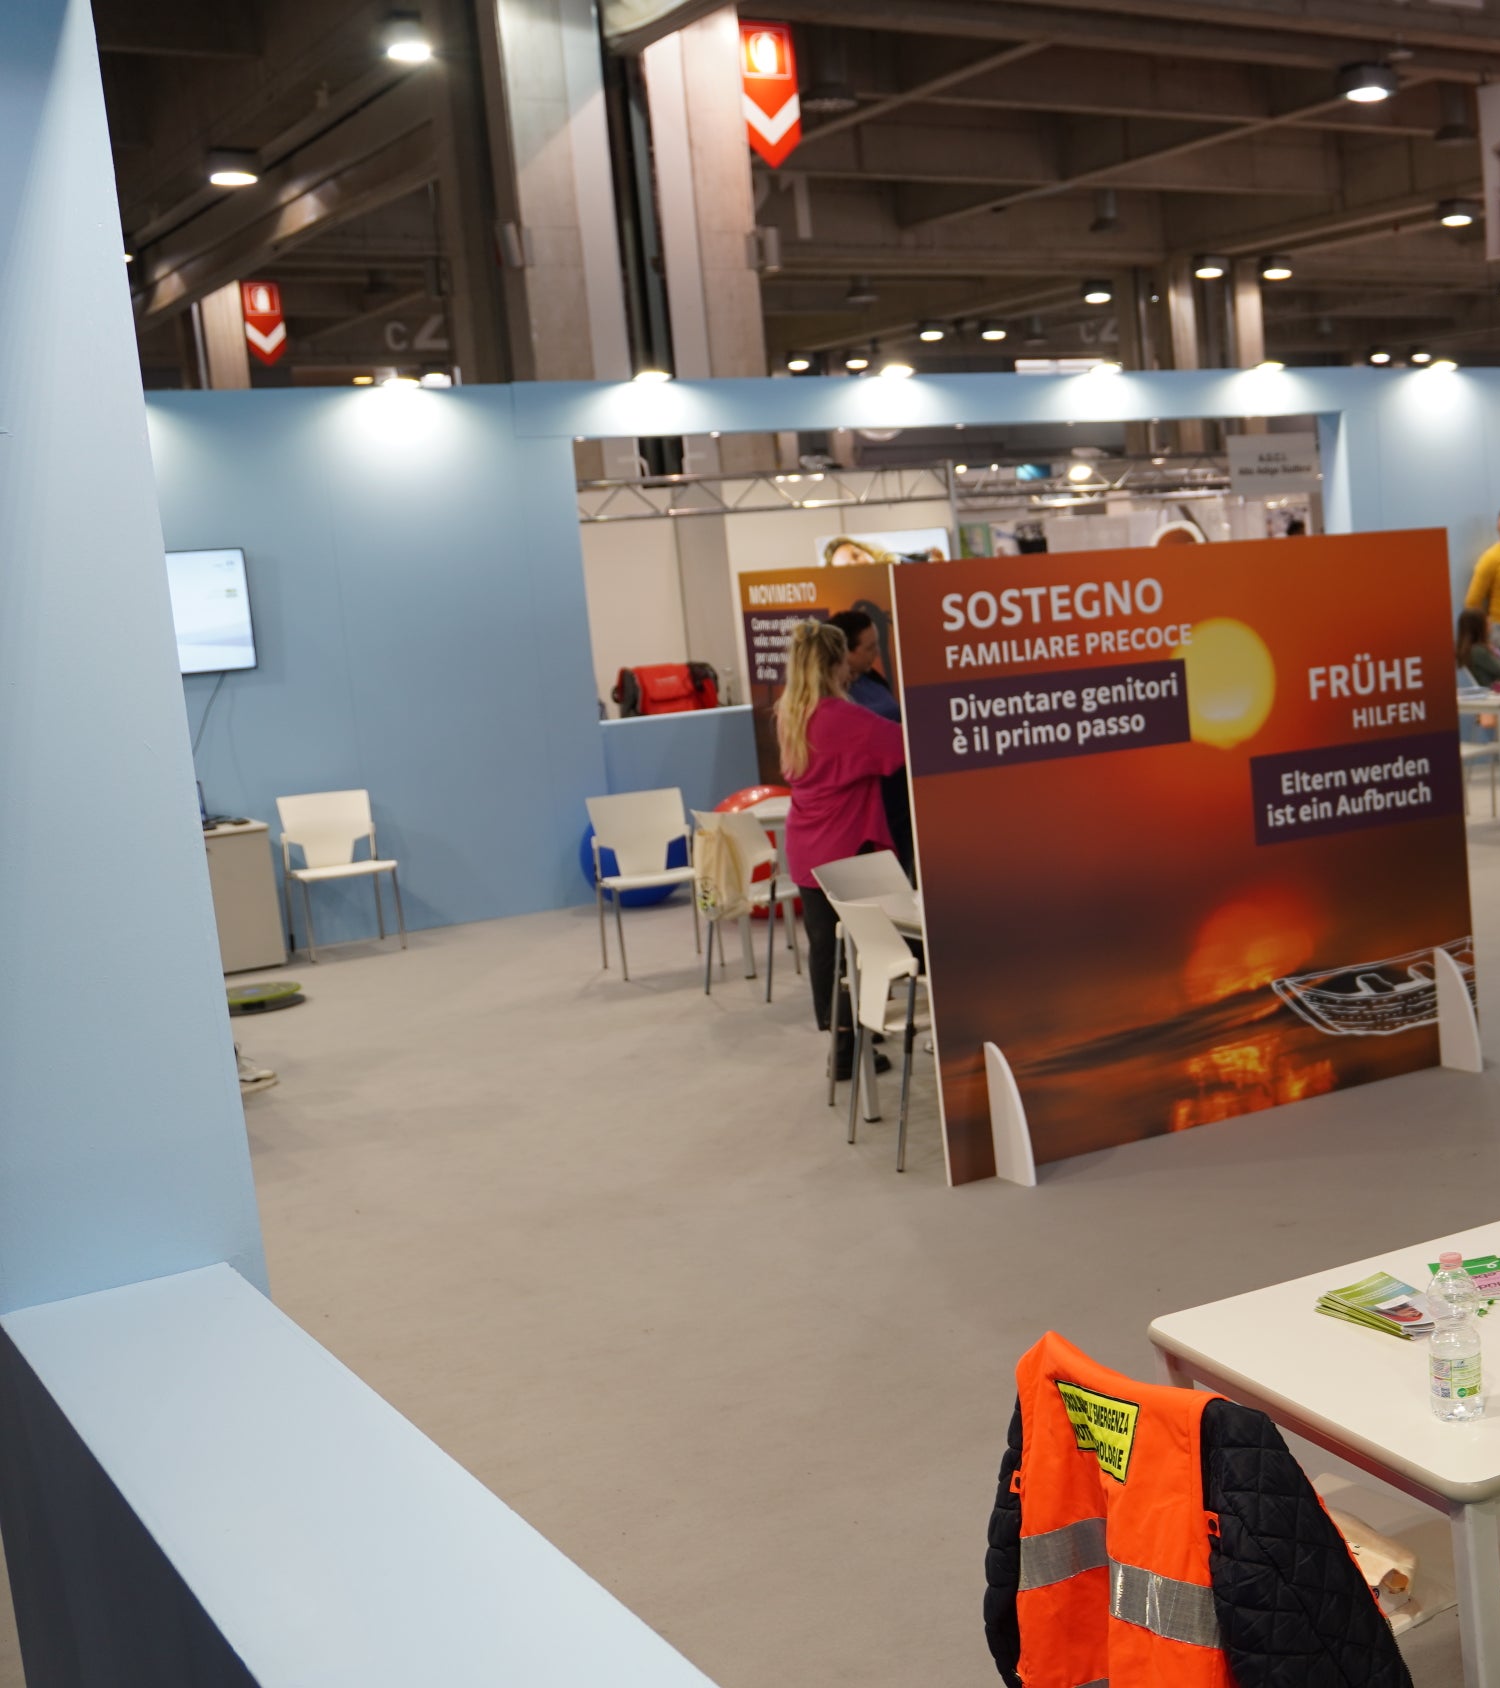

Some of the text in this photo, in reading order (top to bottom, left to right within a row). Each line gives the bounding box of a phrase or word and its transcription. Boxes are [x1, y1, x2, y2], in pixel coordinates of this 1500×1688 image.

[941, 577, 1163, 632] SOSTEGNO
[945, 624, 1193, 669] FAMILIARE PRECOCE
[950, 672, 1179, 722] Diventare genitori
[1308, 653, 1424, 700] FRÜHE
[952, 713, 1146, 755] è il primo passo
[1352, 701, 1426, 729] HILFEN
[1281, 756, 1430, 795] Eltern werden
[1266, 782, 1432, 827] ist ein Aufbruch
